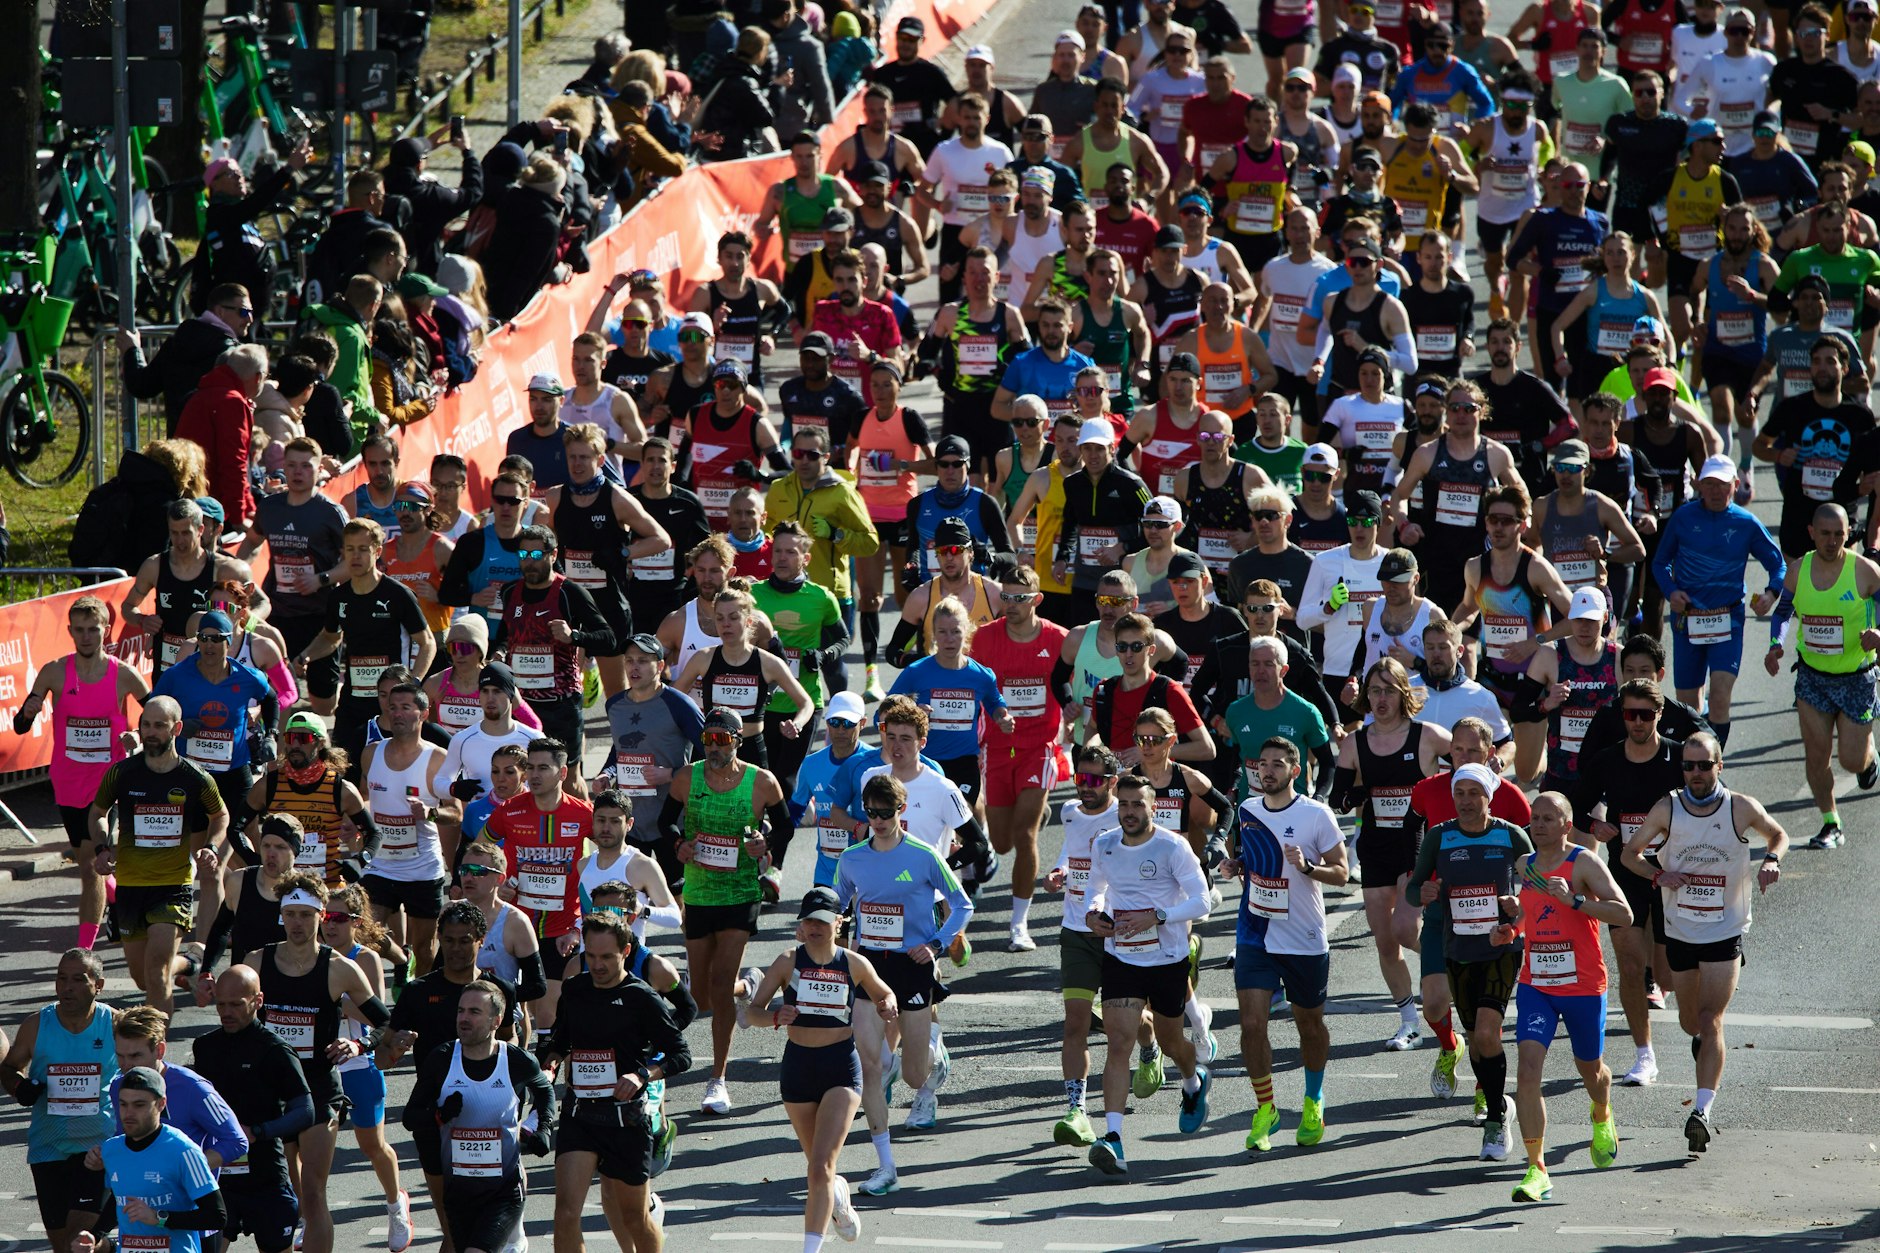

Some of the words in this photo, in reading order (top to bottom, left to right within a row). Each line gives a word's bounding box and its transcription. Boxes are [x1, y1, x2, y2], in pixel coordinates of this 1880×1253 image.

[1449, 485, 1479, 493] GENERALI
[1446, 493, 1472, 502] 32053
[269, 541, 308, 549] MARATHON
[1086, 538, 1109, 546] 27128
[1561, 562, 1588, 571] 32616
[1491, 627, 1519, 635] 24467
[1808, 627, 1834, 635] 40668
[519, 656, 545, 664] 25440
[356, 668, 381, 676] 39091
[1568, 682, 1606, 690] SAYSKY
[722, 687, 749, 695] 19723
[942, 690, 972, 698] GENERALI
[1010, 688, 1037, 696] 36182
[451, 696, 480, 705] GENERAL
[939, 701, 967, 709] 54021
[448, 706, 476, 716] 62043
[1569, 708, 1596, 717] GENERA
[74, 729, 102, 737] 31444
[199, 730, 231, 739] GENERALI
[195, 740, 224, 750] 55455
[1168, 789, 1185, 797] BRC
[1382, 787, 1413, 796] GENERALI
[146, 806, 180, 814] GENERALI
[1153, 811, 1171, 819] 142
[144, 816, 173, 824] 50424
[299, 815, 323, 825] ETICA
[383, 816, 413, 824] GENERALI
[381, 826, 407, 835] 15055
[826, 830, 848, 838] 1483
[704, 836, 736, 845] GENERALI
[299, 845, 317, 853] 097
[701, 845, 728, 855] 23194
[1676, 843, 1730, 862] SANKTHANSHAUGEN
[1070, 858, 1091, 868] GENER
[527, 876, 557, 884] 18865
[1072, 872, 1089, 880] 5263
[1257, 877, 1287, 887] GENERALI
[1692, 877, 1724, 885] GENERALI
[1255, 887, 1278, 898] 31541
[1686, 887, 1716, 896] 23862
[1458, 899, 1489, 908] 61848
[866, 916, 894, 925] 24536
[1537, 955, 1566, 963] 24105
[813, 972, 844, 982] GENERALI
[808, 982, 839, 992] 14393
[274, 1026, 304, 1035] 36193
[579, 1052, 611, 1060] GENERALI
[578, 1064, 606, 1073] 26263
[59, 1078, 89, 1086] 50711
[462, 1130, 498, 1138] GENERALI
[459, 1142, 492, 1151] 52212
[131, 1237, 166, 1246] GENERALI
